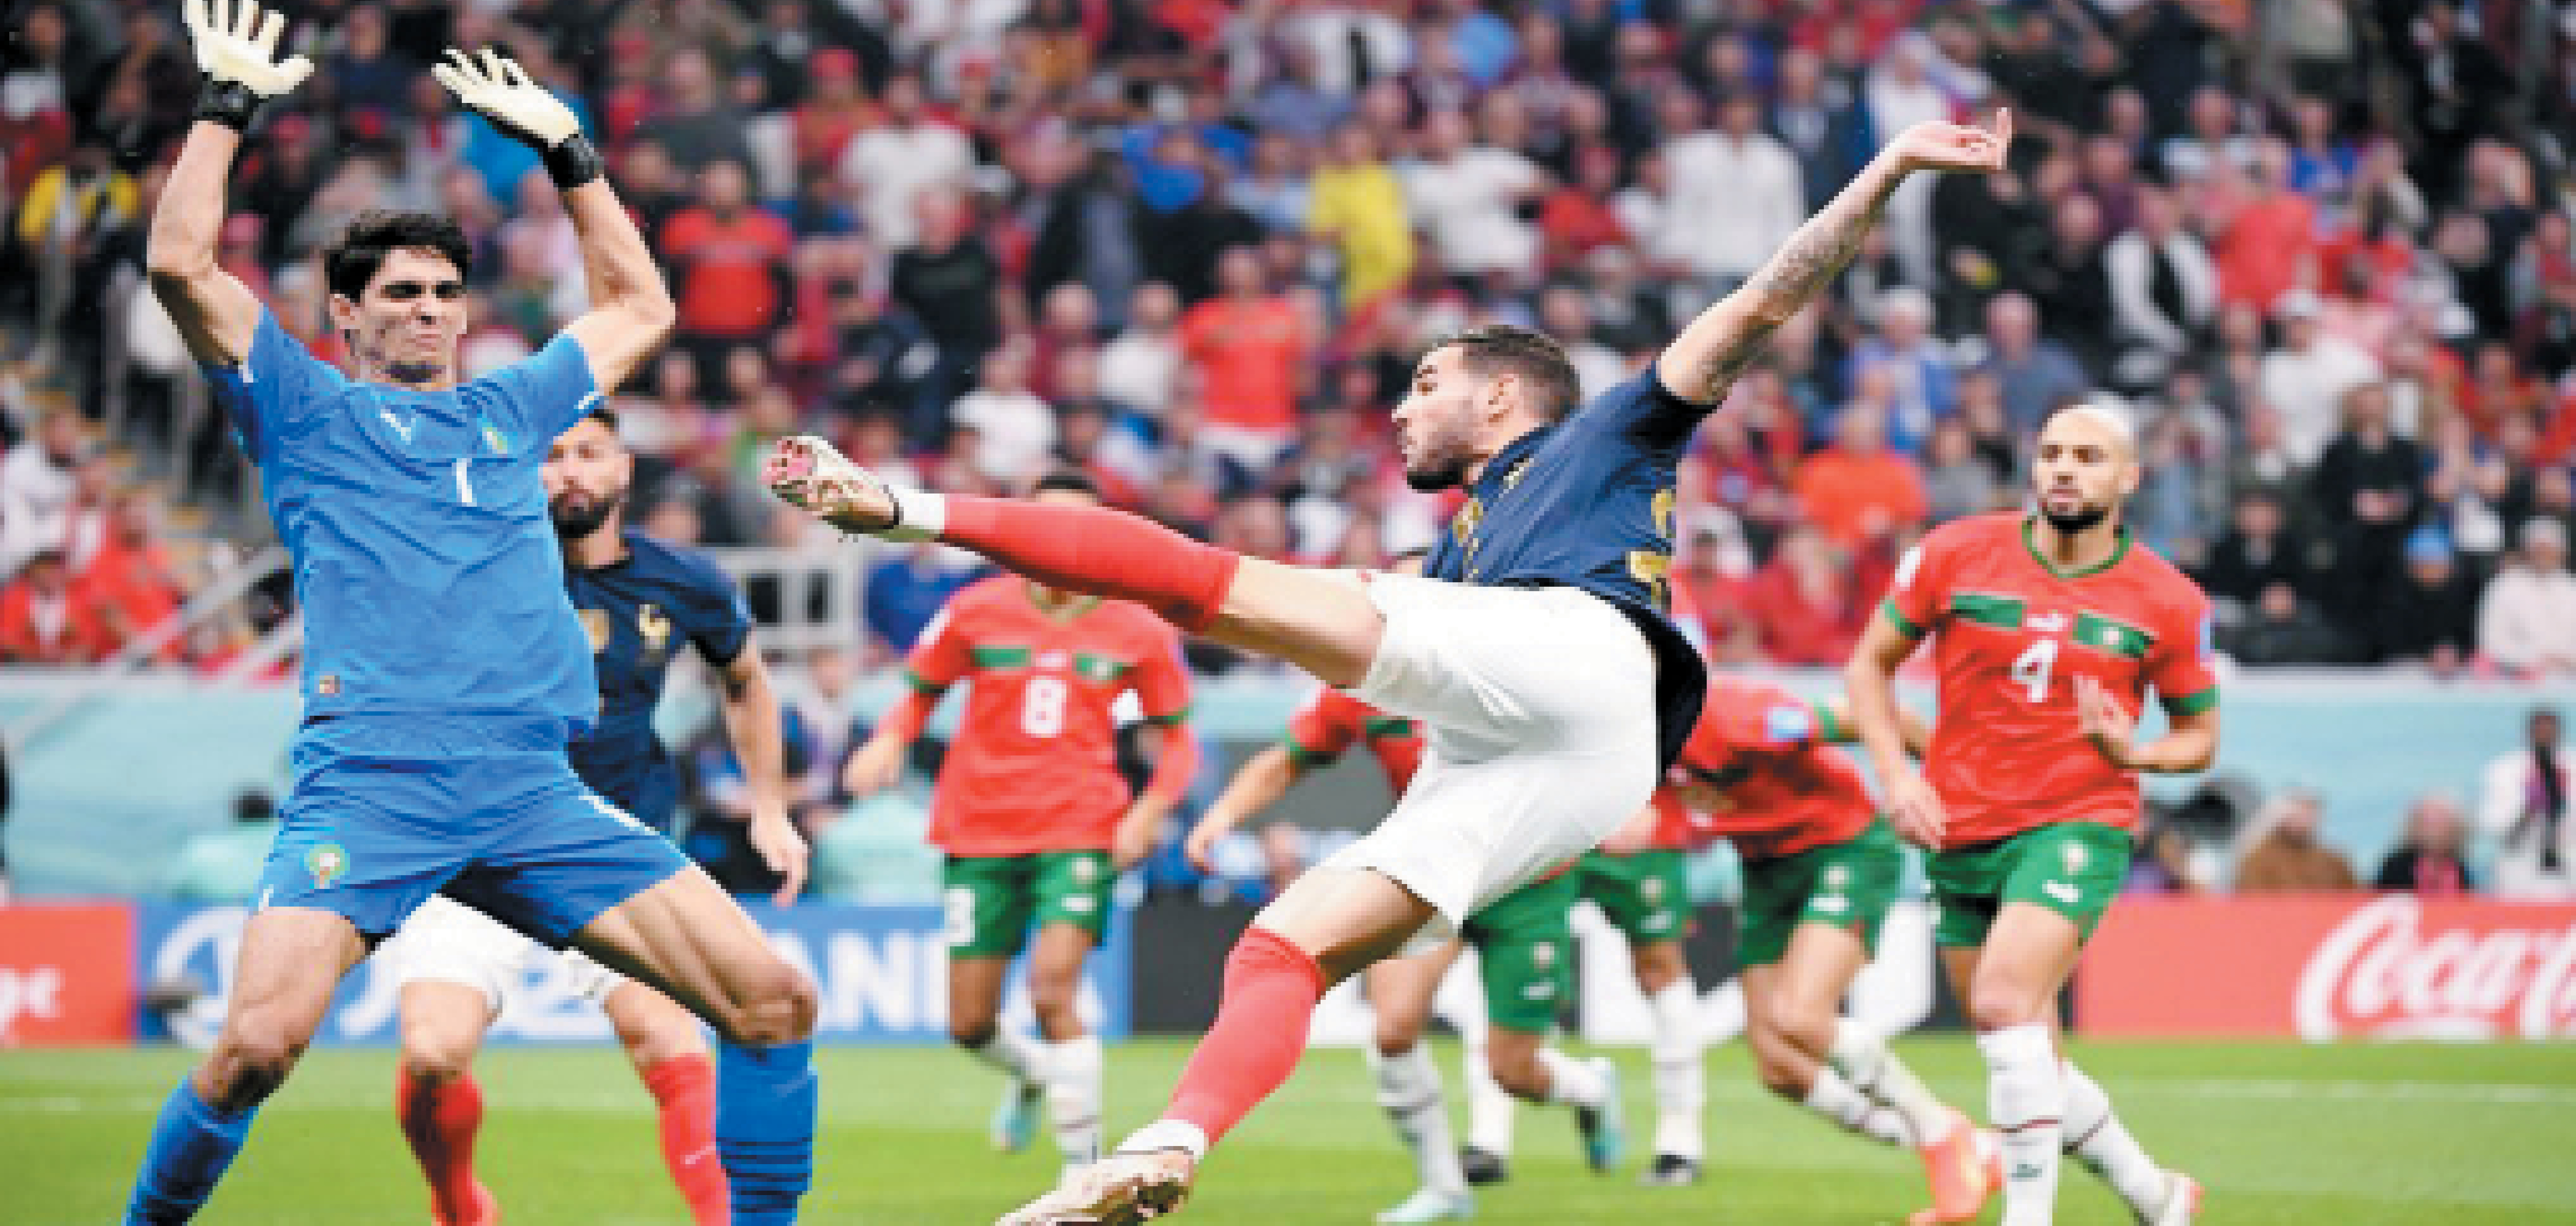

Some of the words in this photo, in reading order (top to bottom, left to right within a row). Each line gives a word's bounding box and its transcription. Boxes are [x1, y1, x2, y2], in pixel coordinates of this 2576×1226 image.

[454, 458, 476, 506] 1
[2011, 639, 2058, 703] 4
[1022, 678, 1066, 737] 8
